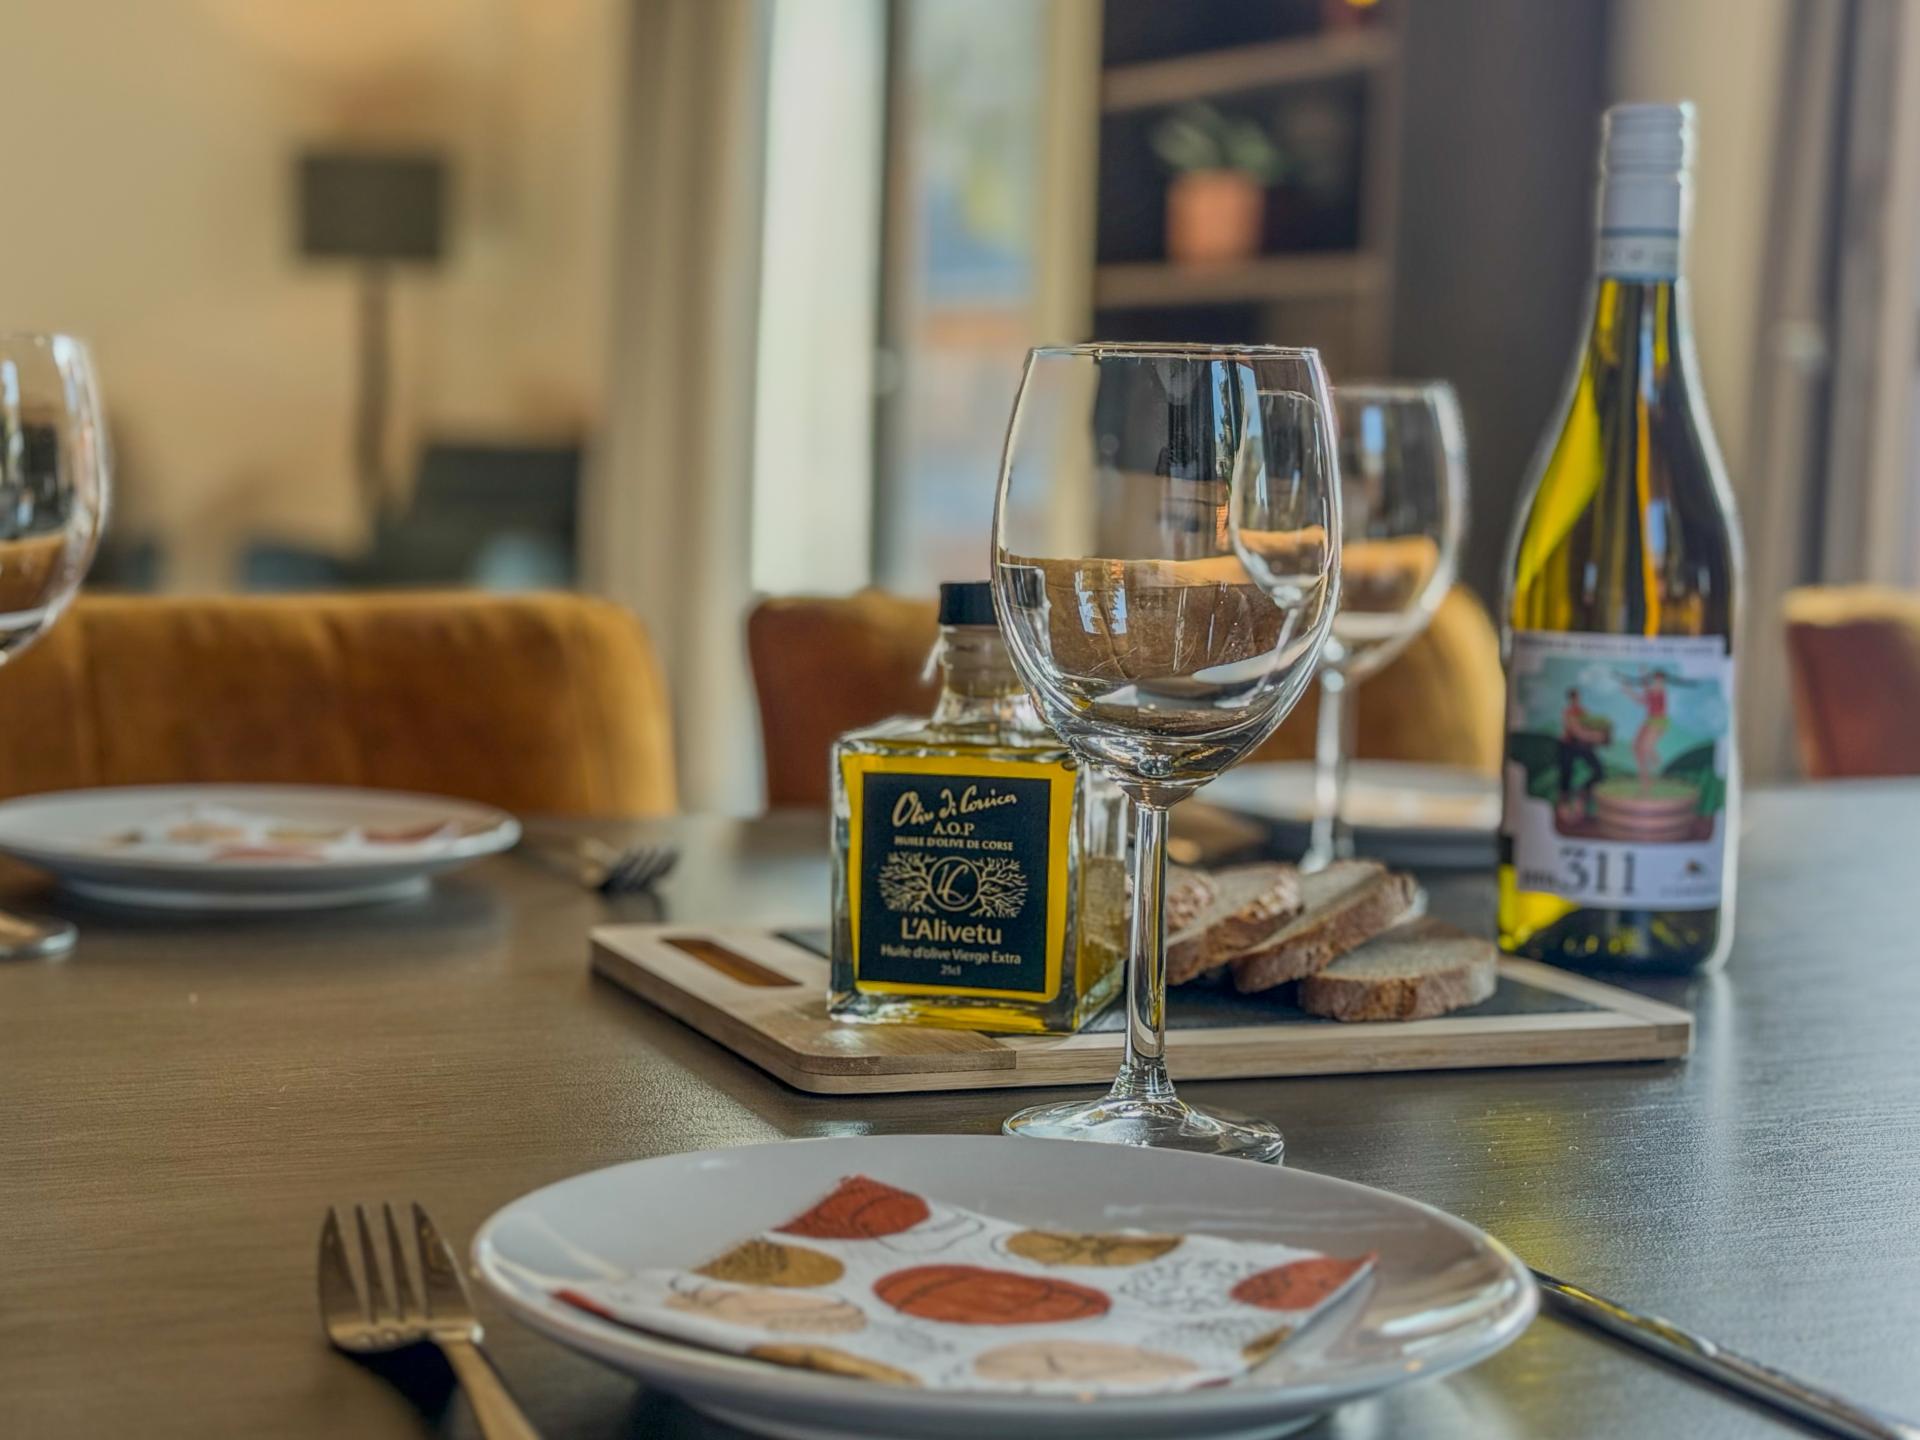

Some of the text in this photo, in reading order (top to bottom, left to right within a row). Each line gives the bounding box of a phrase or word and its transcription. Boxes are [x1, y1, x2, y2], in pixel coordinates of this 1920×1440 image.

[960, 784, 1018, 814] Corsica
[933, 821, 975, 836] A.O.P
[894, 835, 1014, 852] HUILE D'OLIVE DE CORSE
[901, 917, 1003, 945] L'Alivetu
[881, 943, 912, 958] Huile
[952, 948, 989, 965] Vierge
[991, 951, 1022, 965] Extra
